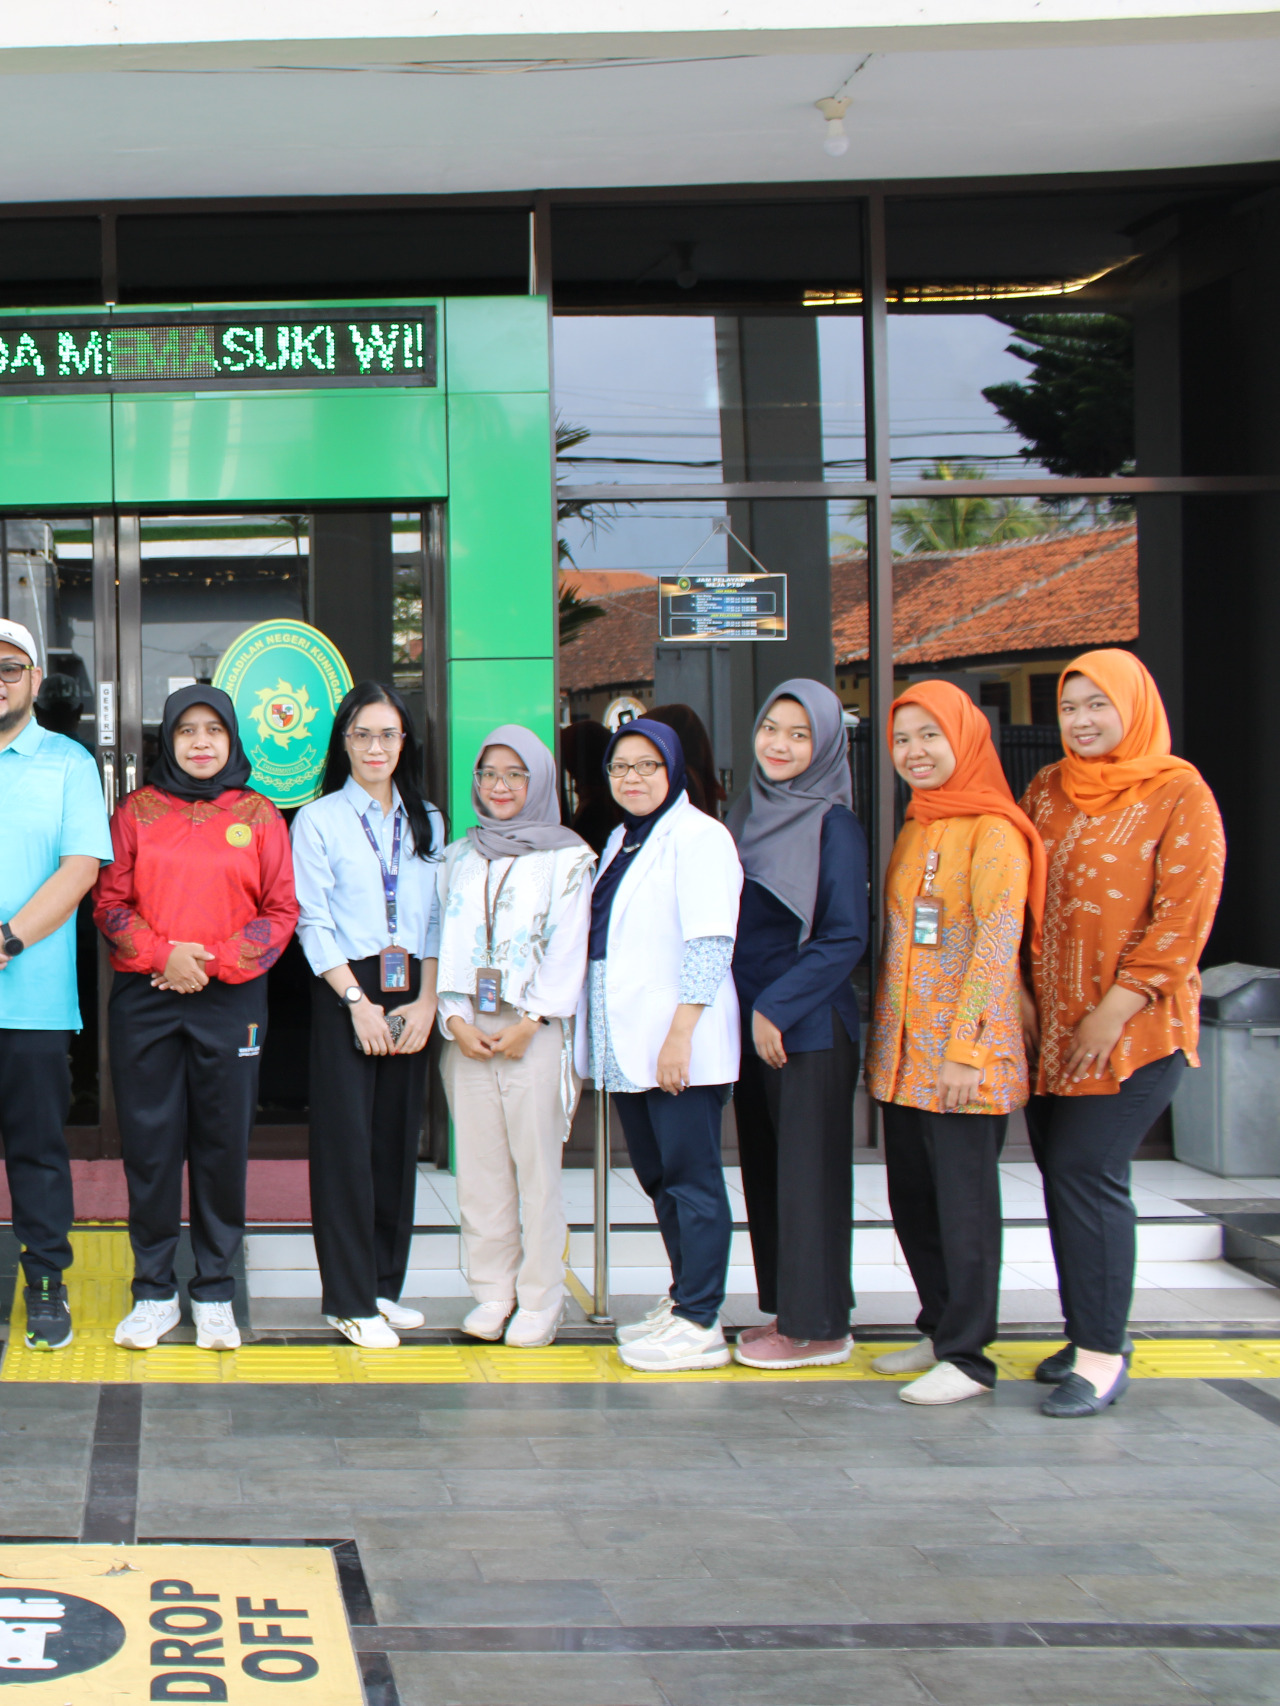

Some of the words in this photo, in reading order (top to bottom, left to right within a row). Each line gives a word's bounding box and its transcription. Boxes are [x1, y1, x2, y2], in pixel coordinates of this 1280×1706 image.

[58, 325, 335, 376] MEMASUKI
[225, 639, 265, 695] NGADILAN
[265, 633, 312, 650] NEGERI
[310, 646, 344, 704] KUNINGAN
[149, 1579, 228, 1702] DROP
[236, 1597, 319, 1682] OFF
